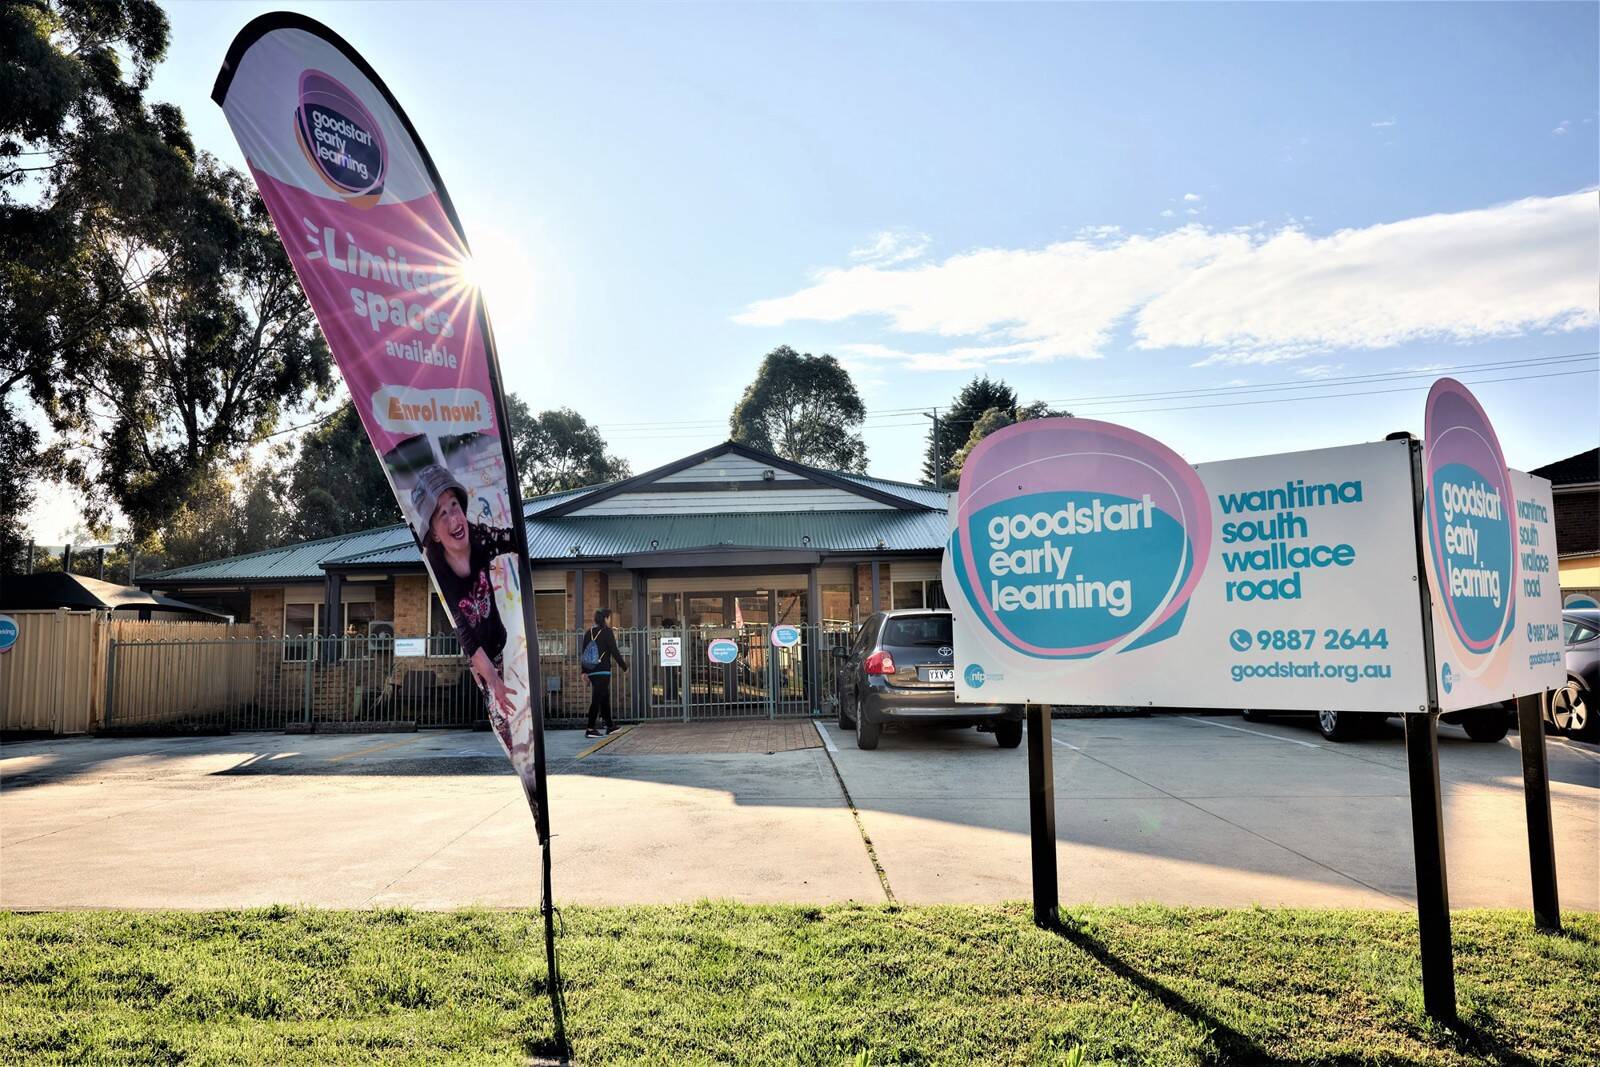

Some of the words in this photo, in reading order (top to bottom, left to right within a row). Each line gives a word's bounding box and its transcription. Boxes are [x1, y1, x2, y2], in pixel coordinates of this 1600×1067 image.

[312, 109, 373, 147] goodstart
[314, 126, 346, 154] early
[317, 142, 368, 179] learning
[323, 227, 448, 299] Limited
[350, 286, 455, 338] spaces
[385, 340, 457, 369] available
[387, 397, 437, 422] Enrol
[440, 402, 482, 422] now!
[1218, 480, 1363, 514] wantirna
[1442, 481, 1502, 522] goodstart
[1516, 499, 1548, 523] wantirna
[988, 494, 1156, 550] goodstart
[1222, 511, 1309, 544] south
[1519, 525, 1540, 547] south
[1222, 542, 1356, 573] wallace
[1445, 519, 1479, 565] early
[989, 540, 1073, 580] early
[1520, 551, 1550, 574] wallace
[991, 575, 1133, 617] learning
[1226, 572, 1303, 602] road
[1447, 559, 1502, 609] learning
[1523, 576, 1542, 598] road
[0, 628, 15, 636] king
[1257, 629, 1317, 651] 9887
[1324, 628, 1389, 650] 2644
[929, 670, 944, 679] YXV
[1231, 661, 1392, 683] goodstart.org.au
